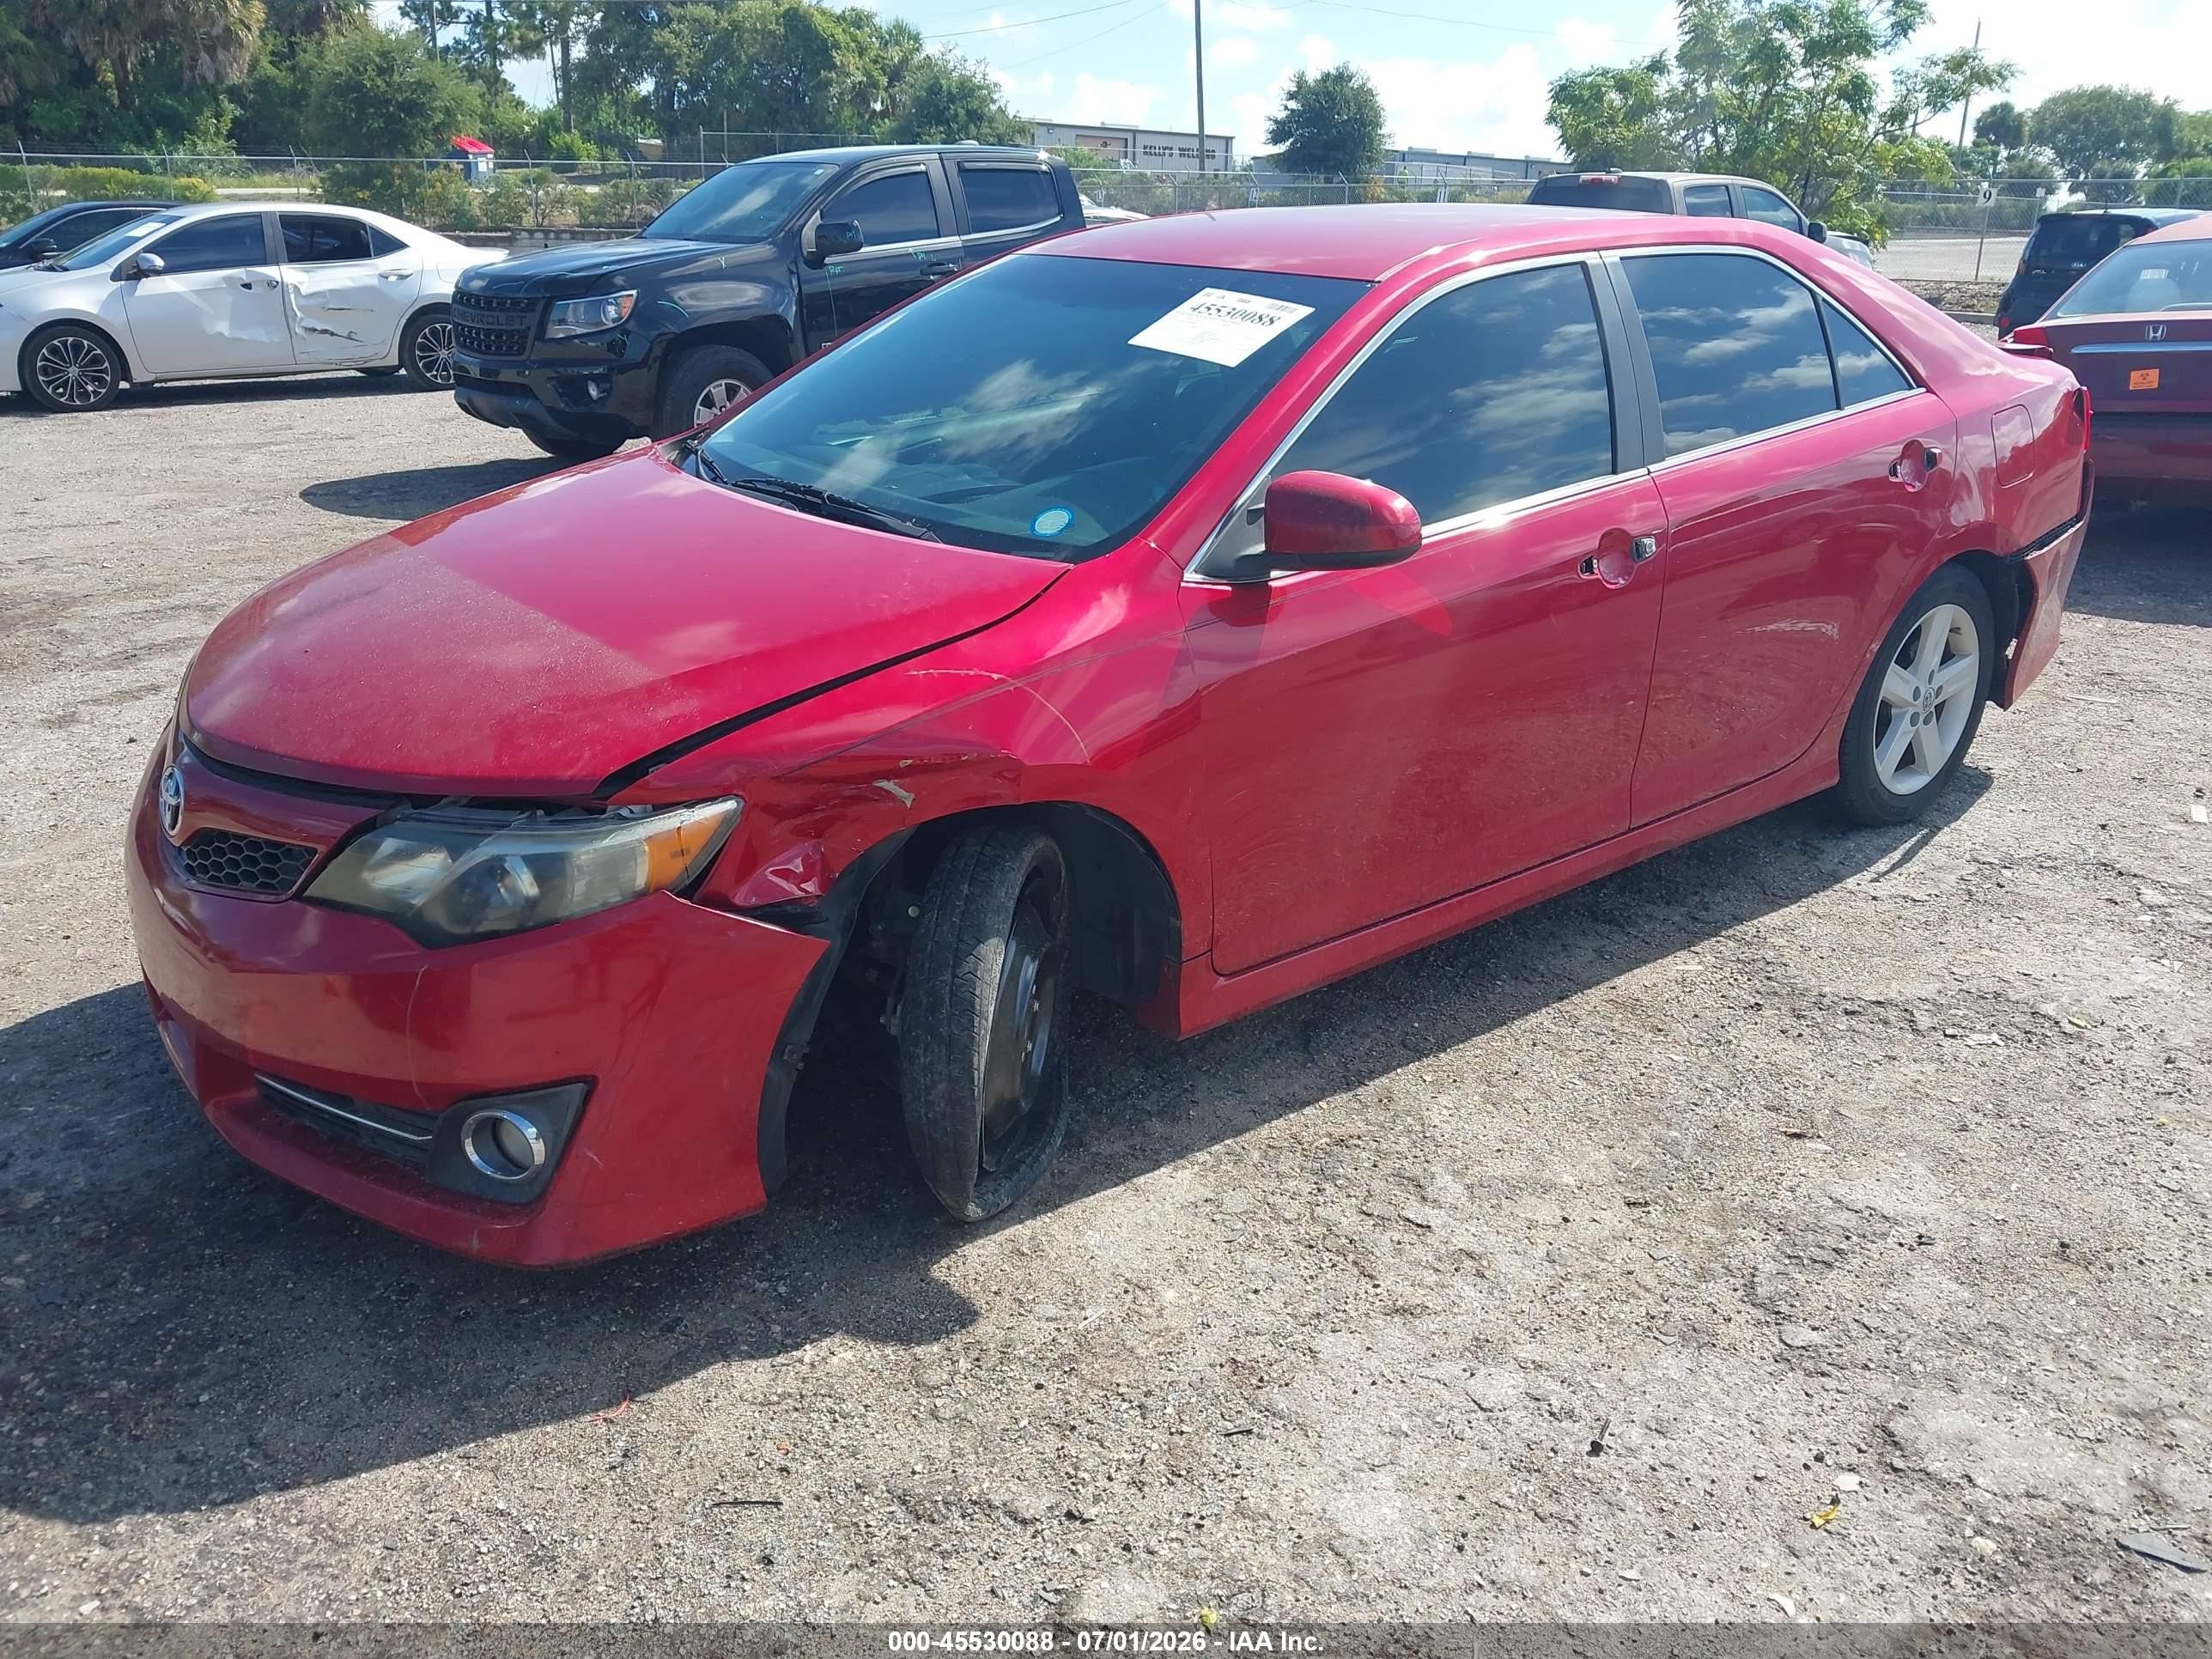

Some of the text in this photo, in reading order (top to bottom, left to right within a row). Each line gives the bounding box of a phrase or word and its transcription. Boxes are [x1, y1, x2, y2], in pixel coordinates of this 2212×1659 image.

[1143, 143, 1216, 160] KELLY'S WELDNG
[1983, 189, 1992, 205] 9
[1190, 301, 1281, 327] 45530088
